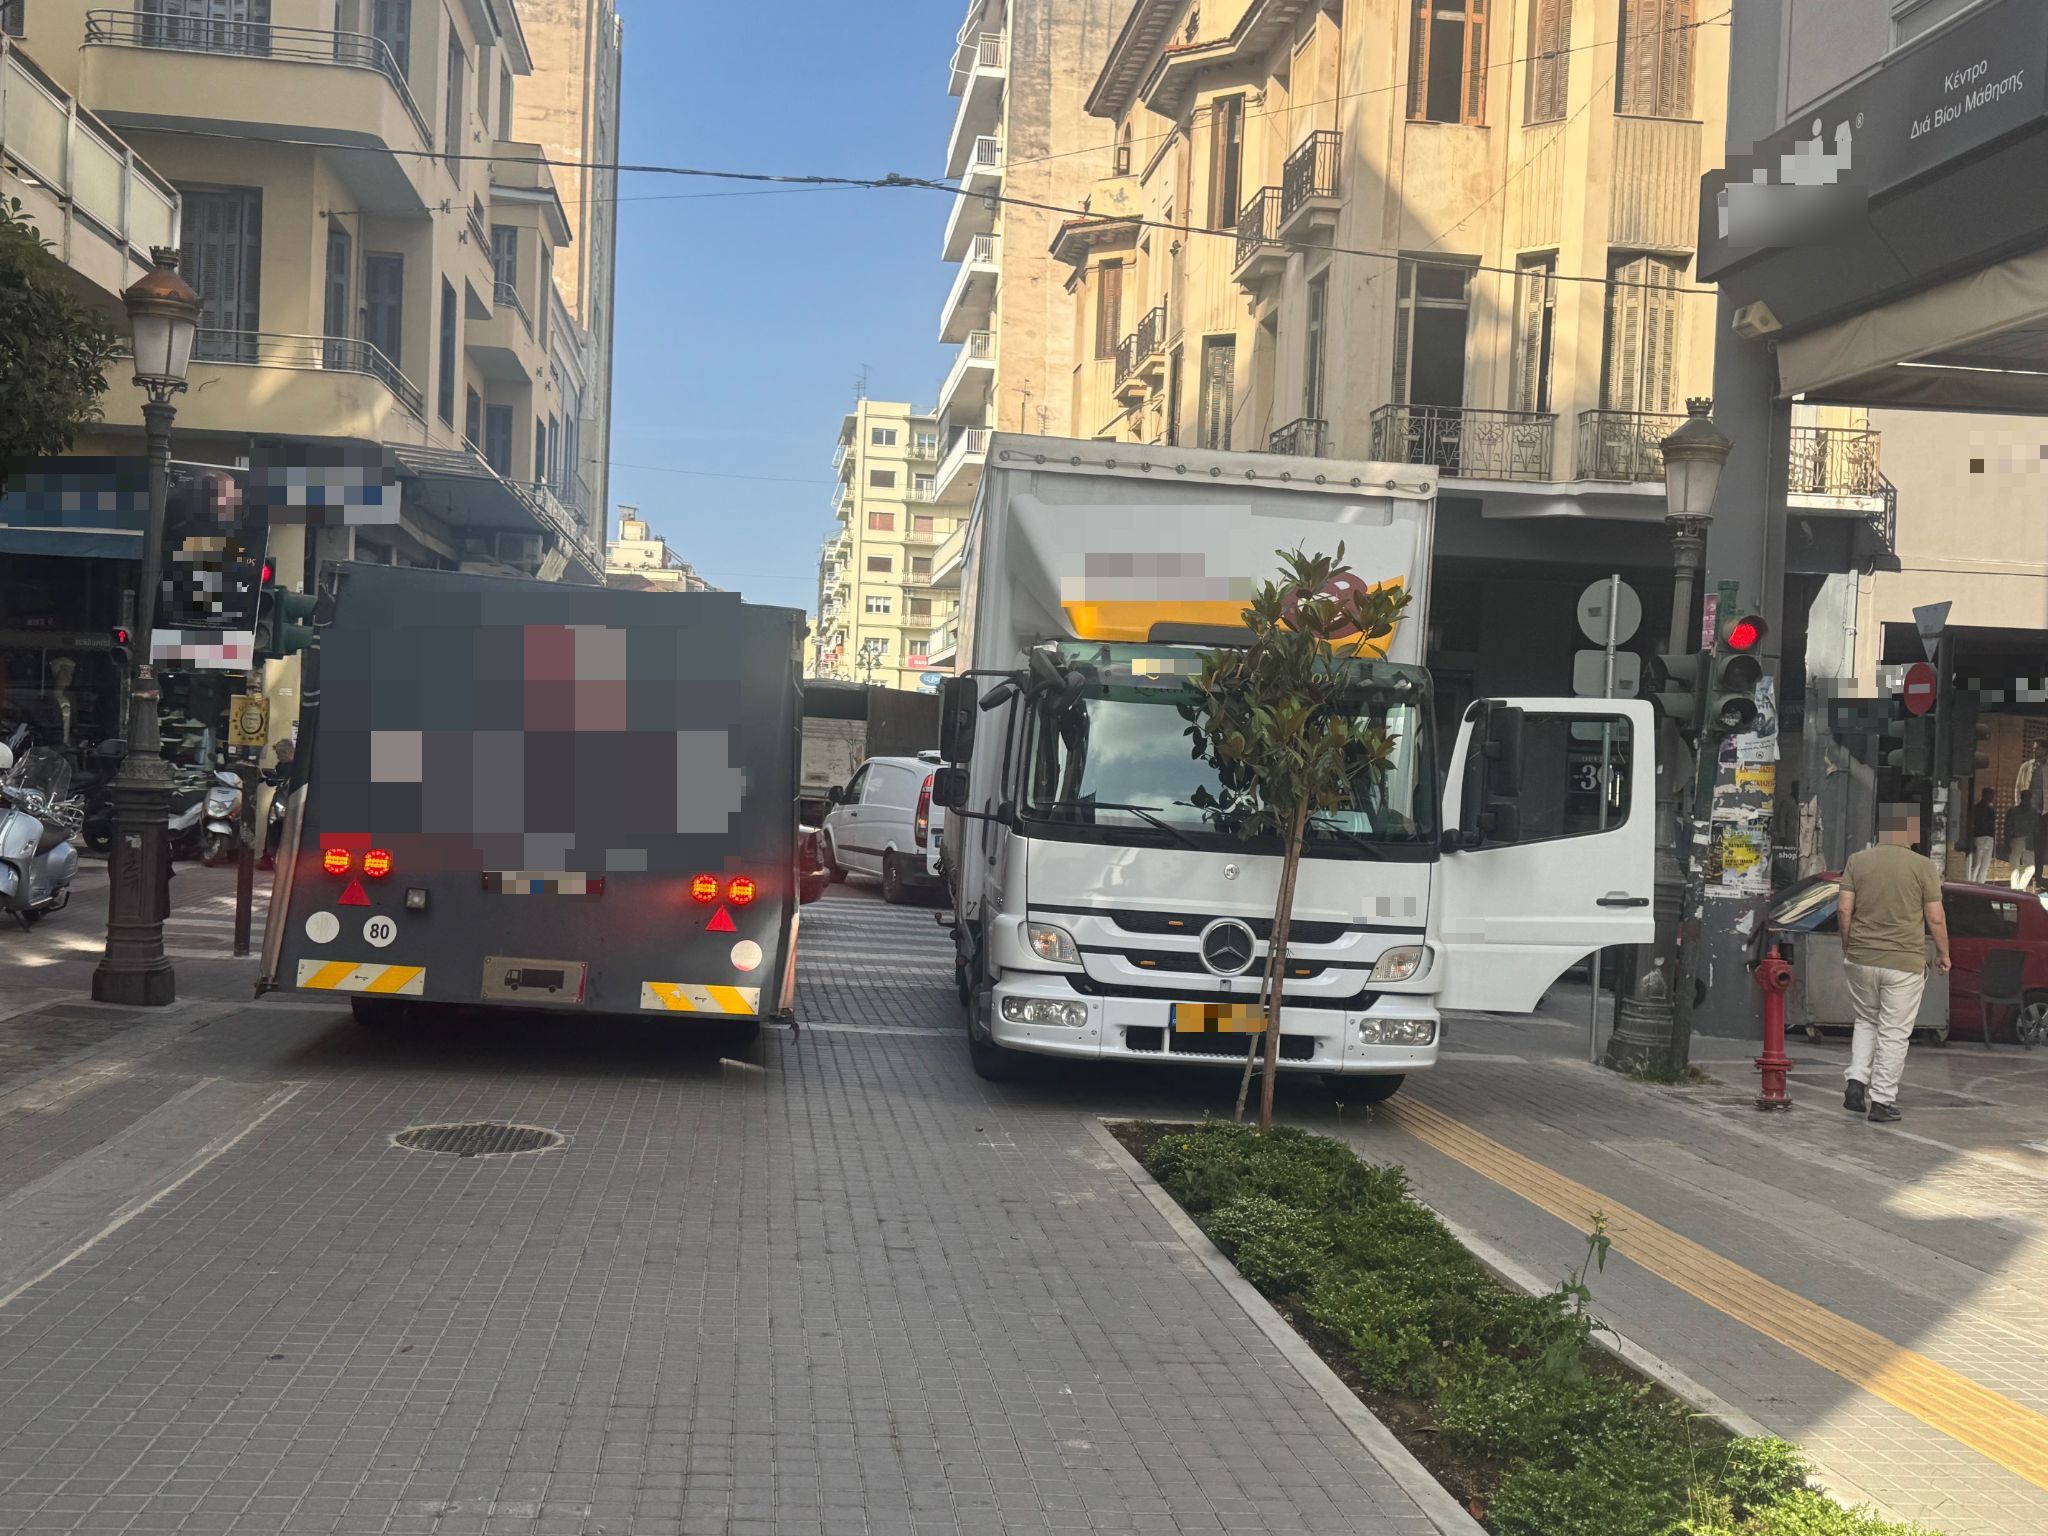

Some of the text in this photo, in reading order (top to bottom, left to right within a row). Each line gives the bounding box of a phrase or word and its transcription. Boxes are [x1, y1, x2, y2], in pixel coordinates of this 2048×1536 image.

[1944, 60, 1988, 93] Κέντρο
[1910, 70, 2024, 139] Διά Βίου Μάθησης
[369, 923, 390, 940] 80
